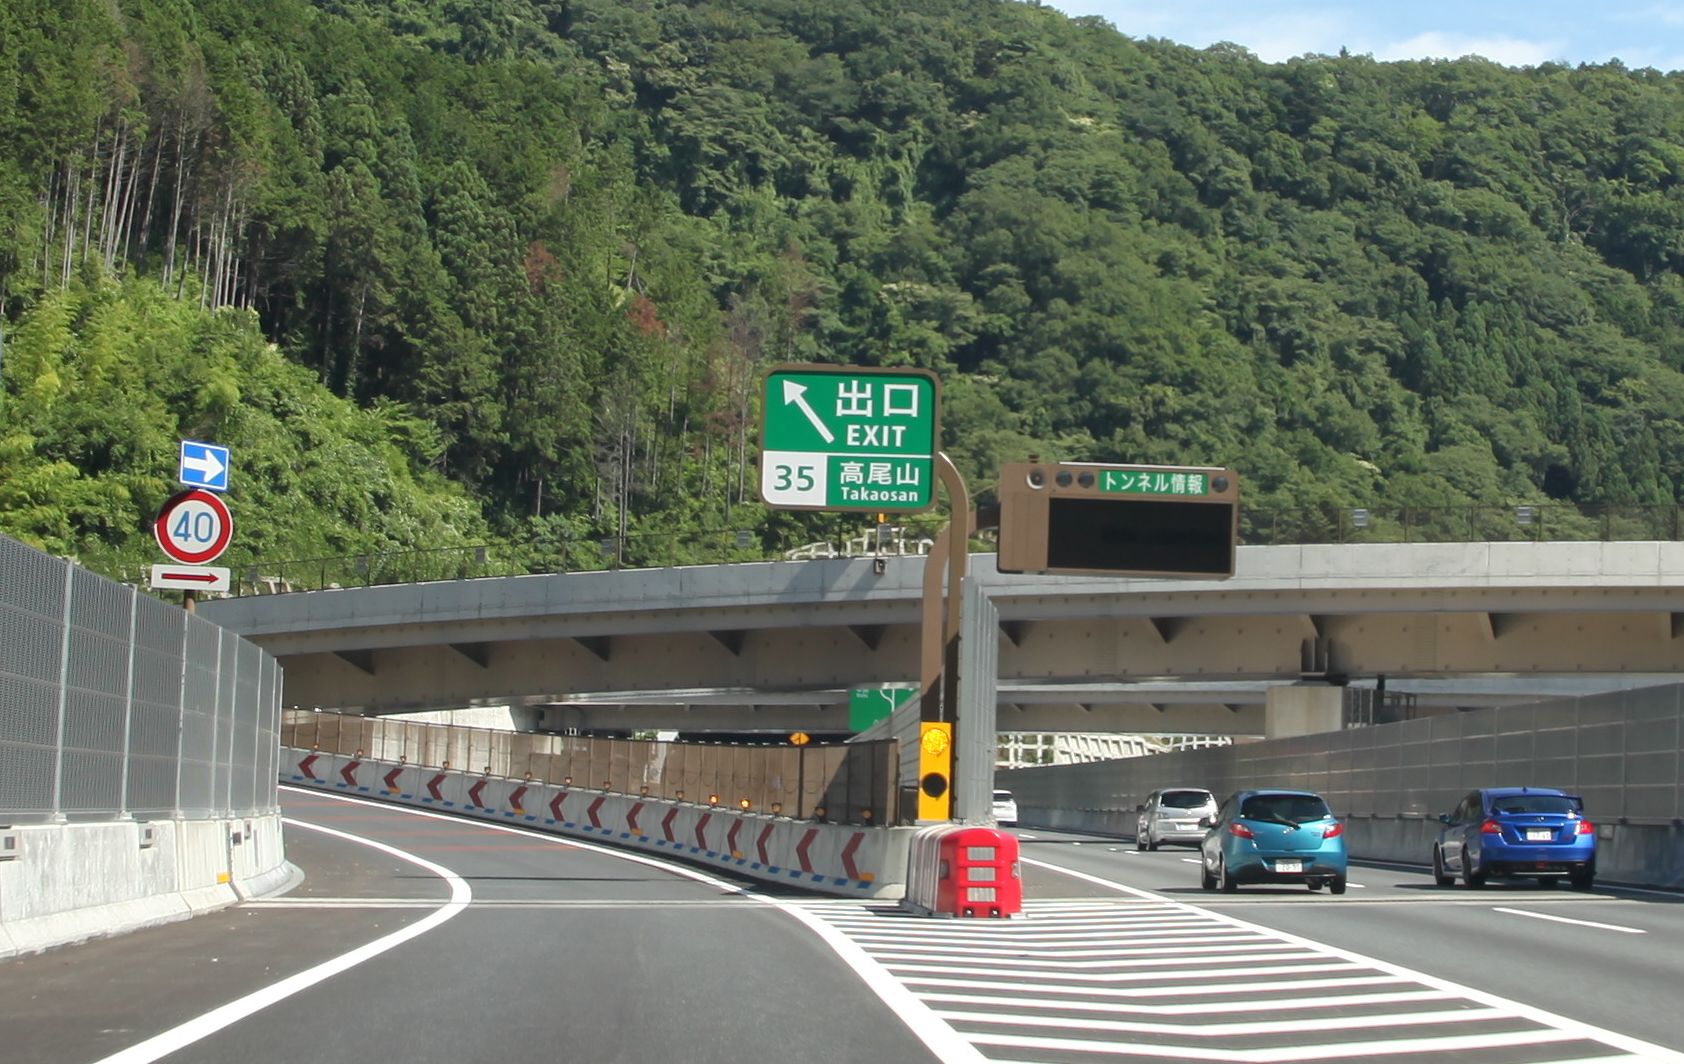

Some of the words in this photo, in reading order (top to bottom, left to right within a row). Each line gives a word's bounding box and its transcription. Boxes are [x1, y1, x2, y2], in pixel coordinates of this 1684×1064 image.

[836, 380, 919, 417] 出口
[846, 424, 906, 447] EXIT
[773, 464, 815, 492] 35
[840, 461, 919, 486] 高尾山
[1105, 471, 1203, 495] トンネル情報
[841, 486, 918, 502] Takaosan
[173, 510, 214, 543] 40
